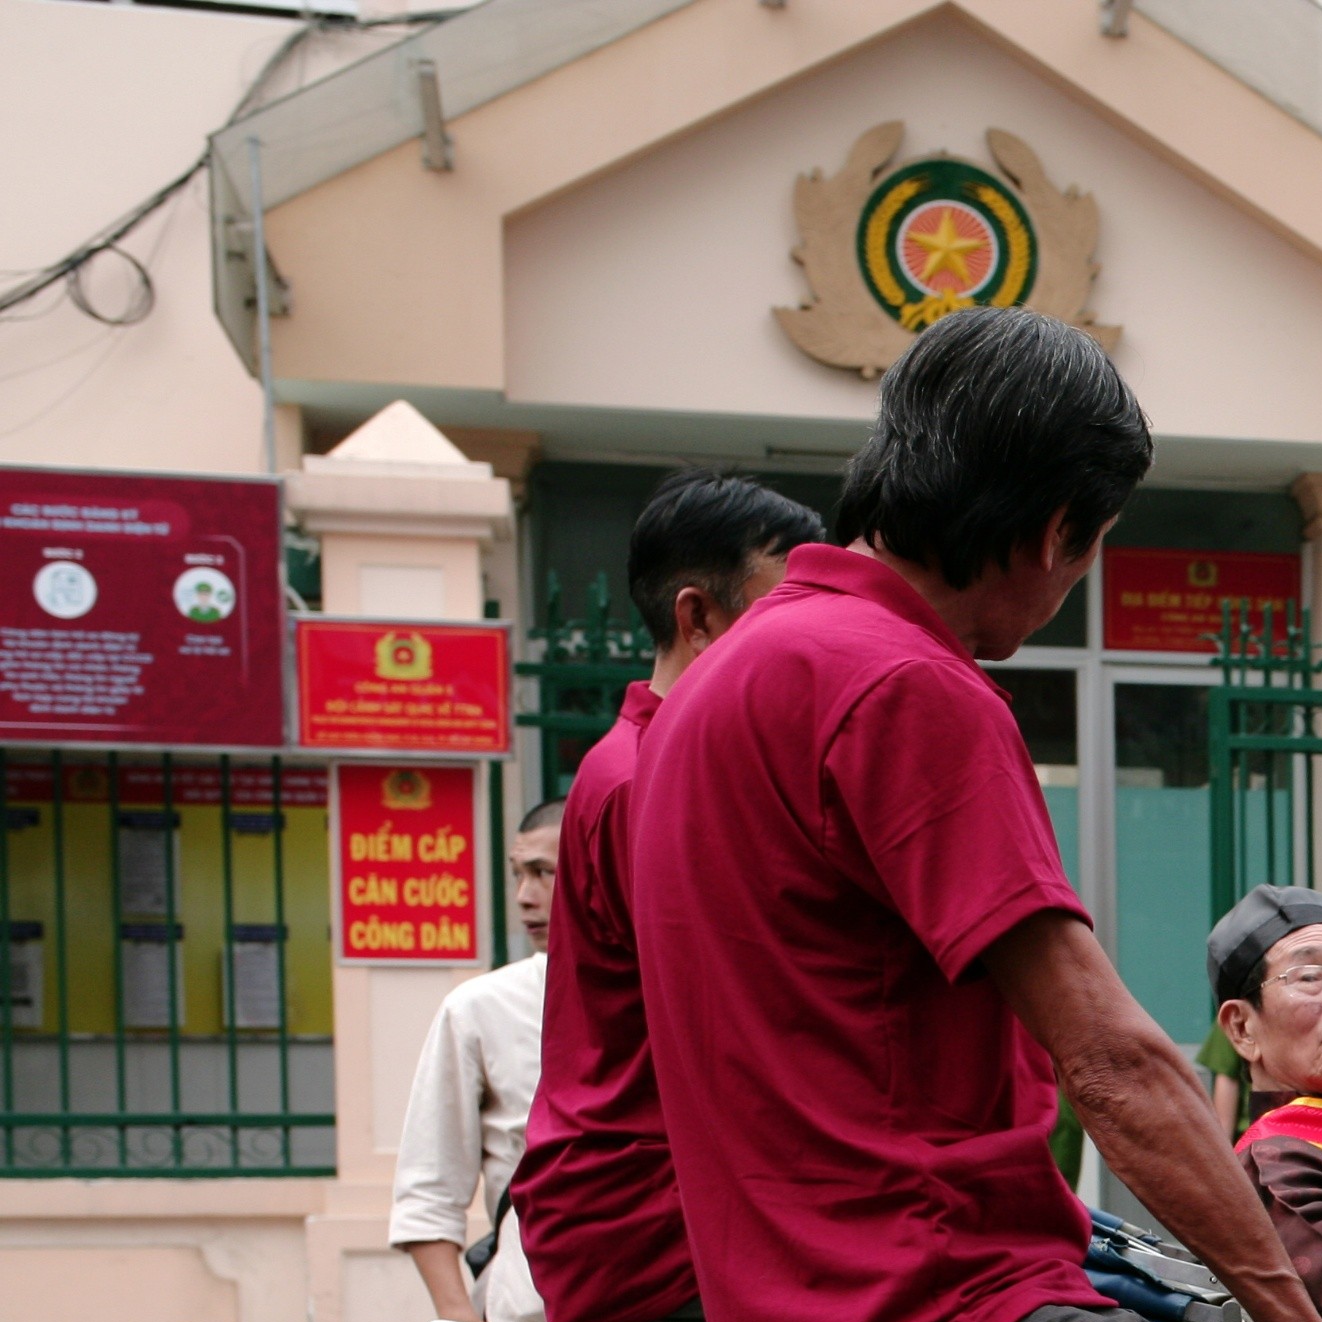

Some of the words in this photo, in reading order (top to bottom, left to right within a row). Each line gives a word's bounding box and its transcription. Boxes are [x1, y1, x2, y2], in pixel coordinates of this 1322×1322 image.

[349, 819, 413, 862] ĐIỂM
[417, 825, 467, 863] CẤP
[349, 872, 398, 906] CĂN
[403, 872, 469, 907] CƯỚC
[349, 914, 416, 950] CÔNG
[419, 915, 471, 950] DÂN
